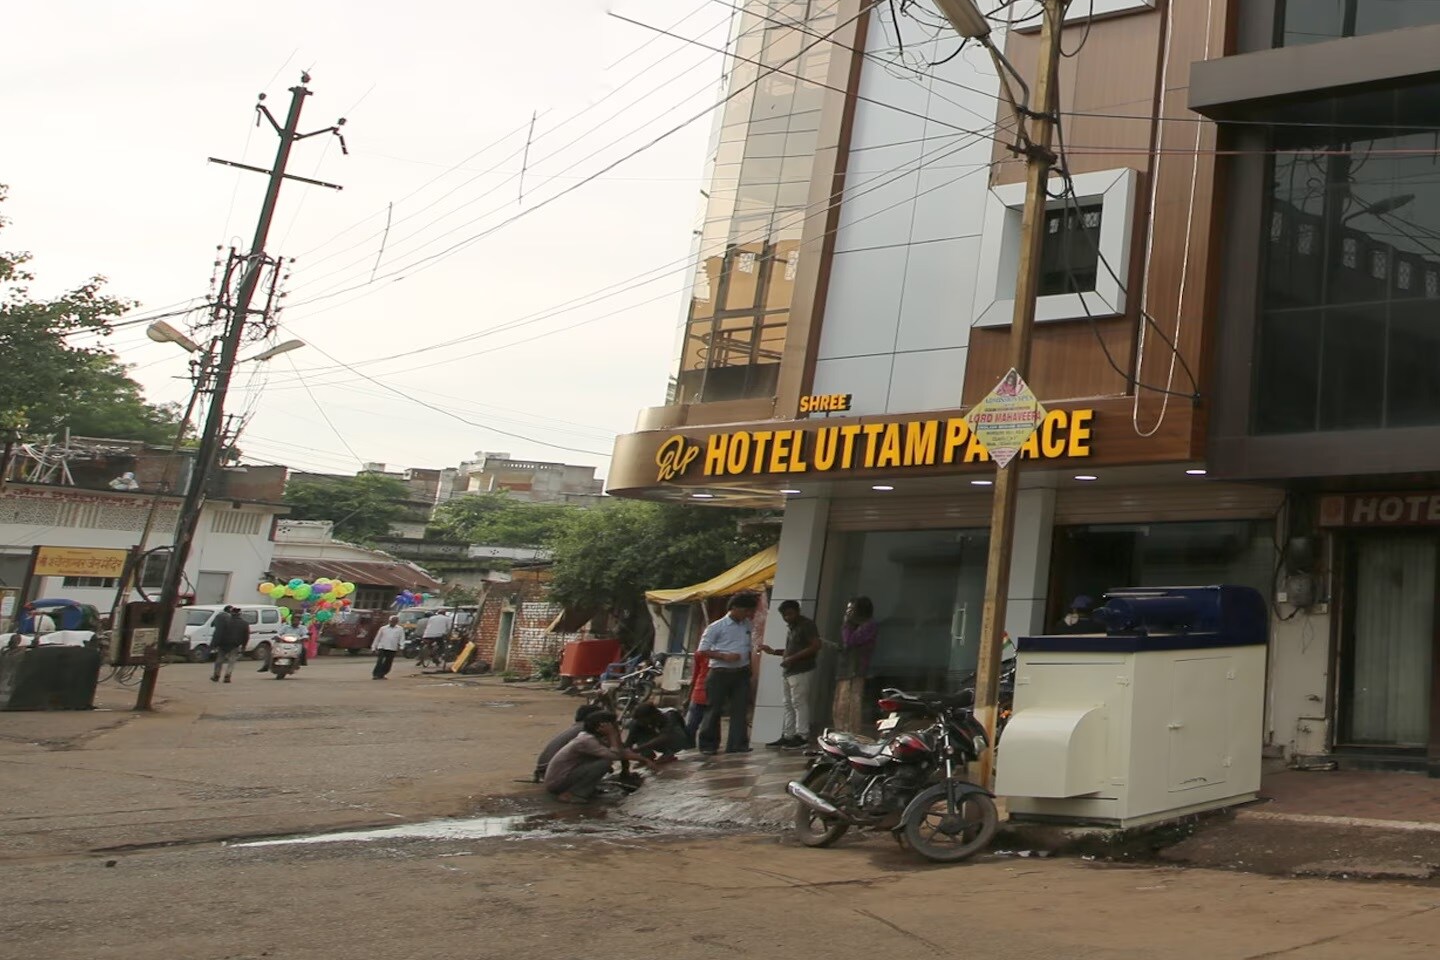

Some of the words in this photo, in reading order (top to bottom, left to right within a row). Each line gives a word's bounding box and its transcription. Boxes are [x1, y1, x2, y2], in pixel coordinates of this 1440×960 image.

[800, 394, 848, 413] SHREE
[969, 413, 993, 423] LORD
[704, 430, 807, 476] HOTEL
[813, 419, 938, 471] UTTAM
[943, 409, 1093, 464] PAACE
